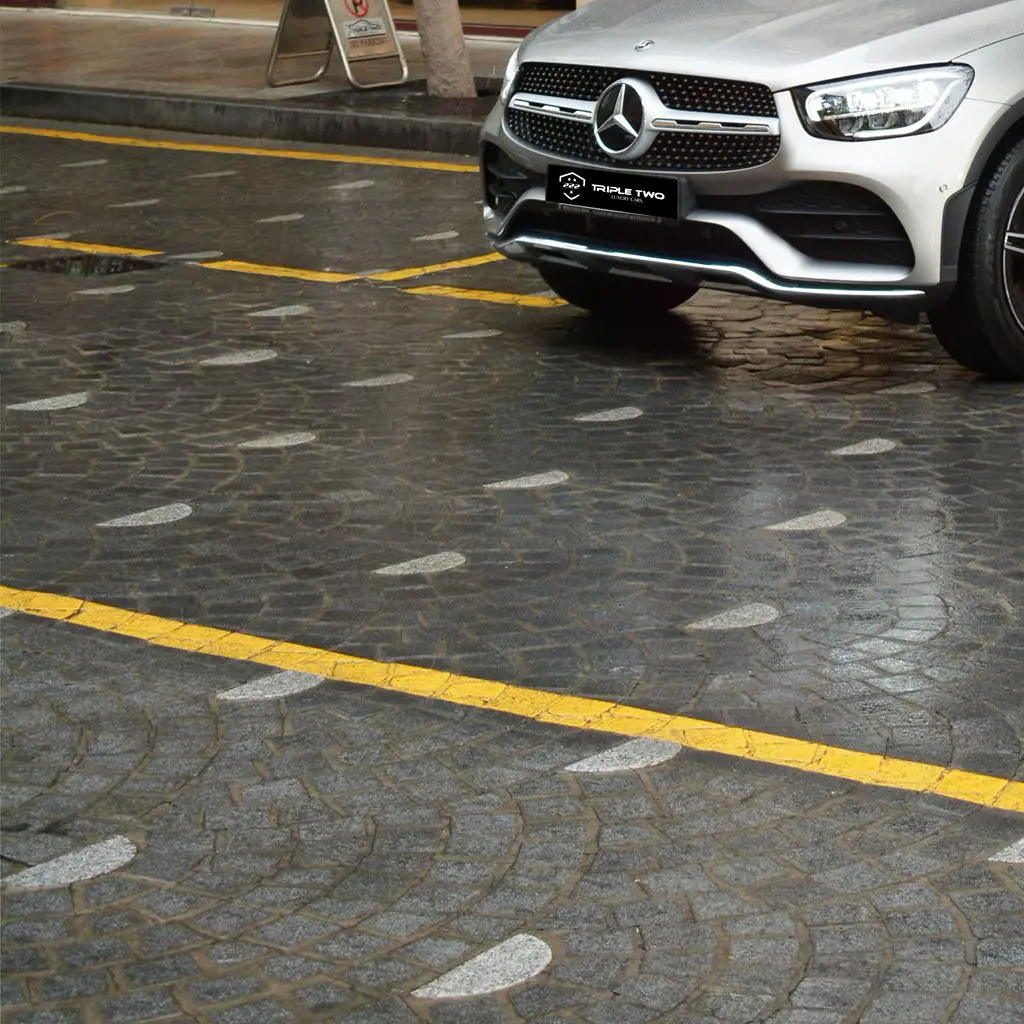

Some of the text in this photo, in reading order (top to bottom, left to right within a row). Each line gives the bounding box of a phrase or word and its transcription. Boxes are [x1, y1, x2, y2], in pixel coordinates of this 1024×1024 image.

[562, 181, 581, 189] 222
[591, 183, 666, 201] TRIPLE TWO
